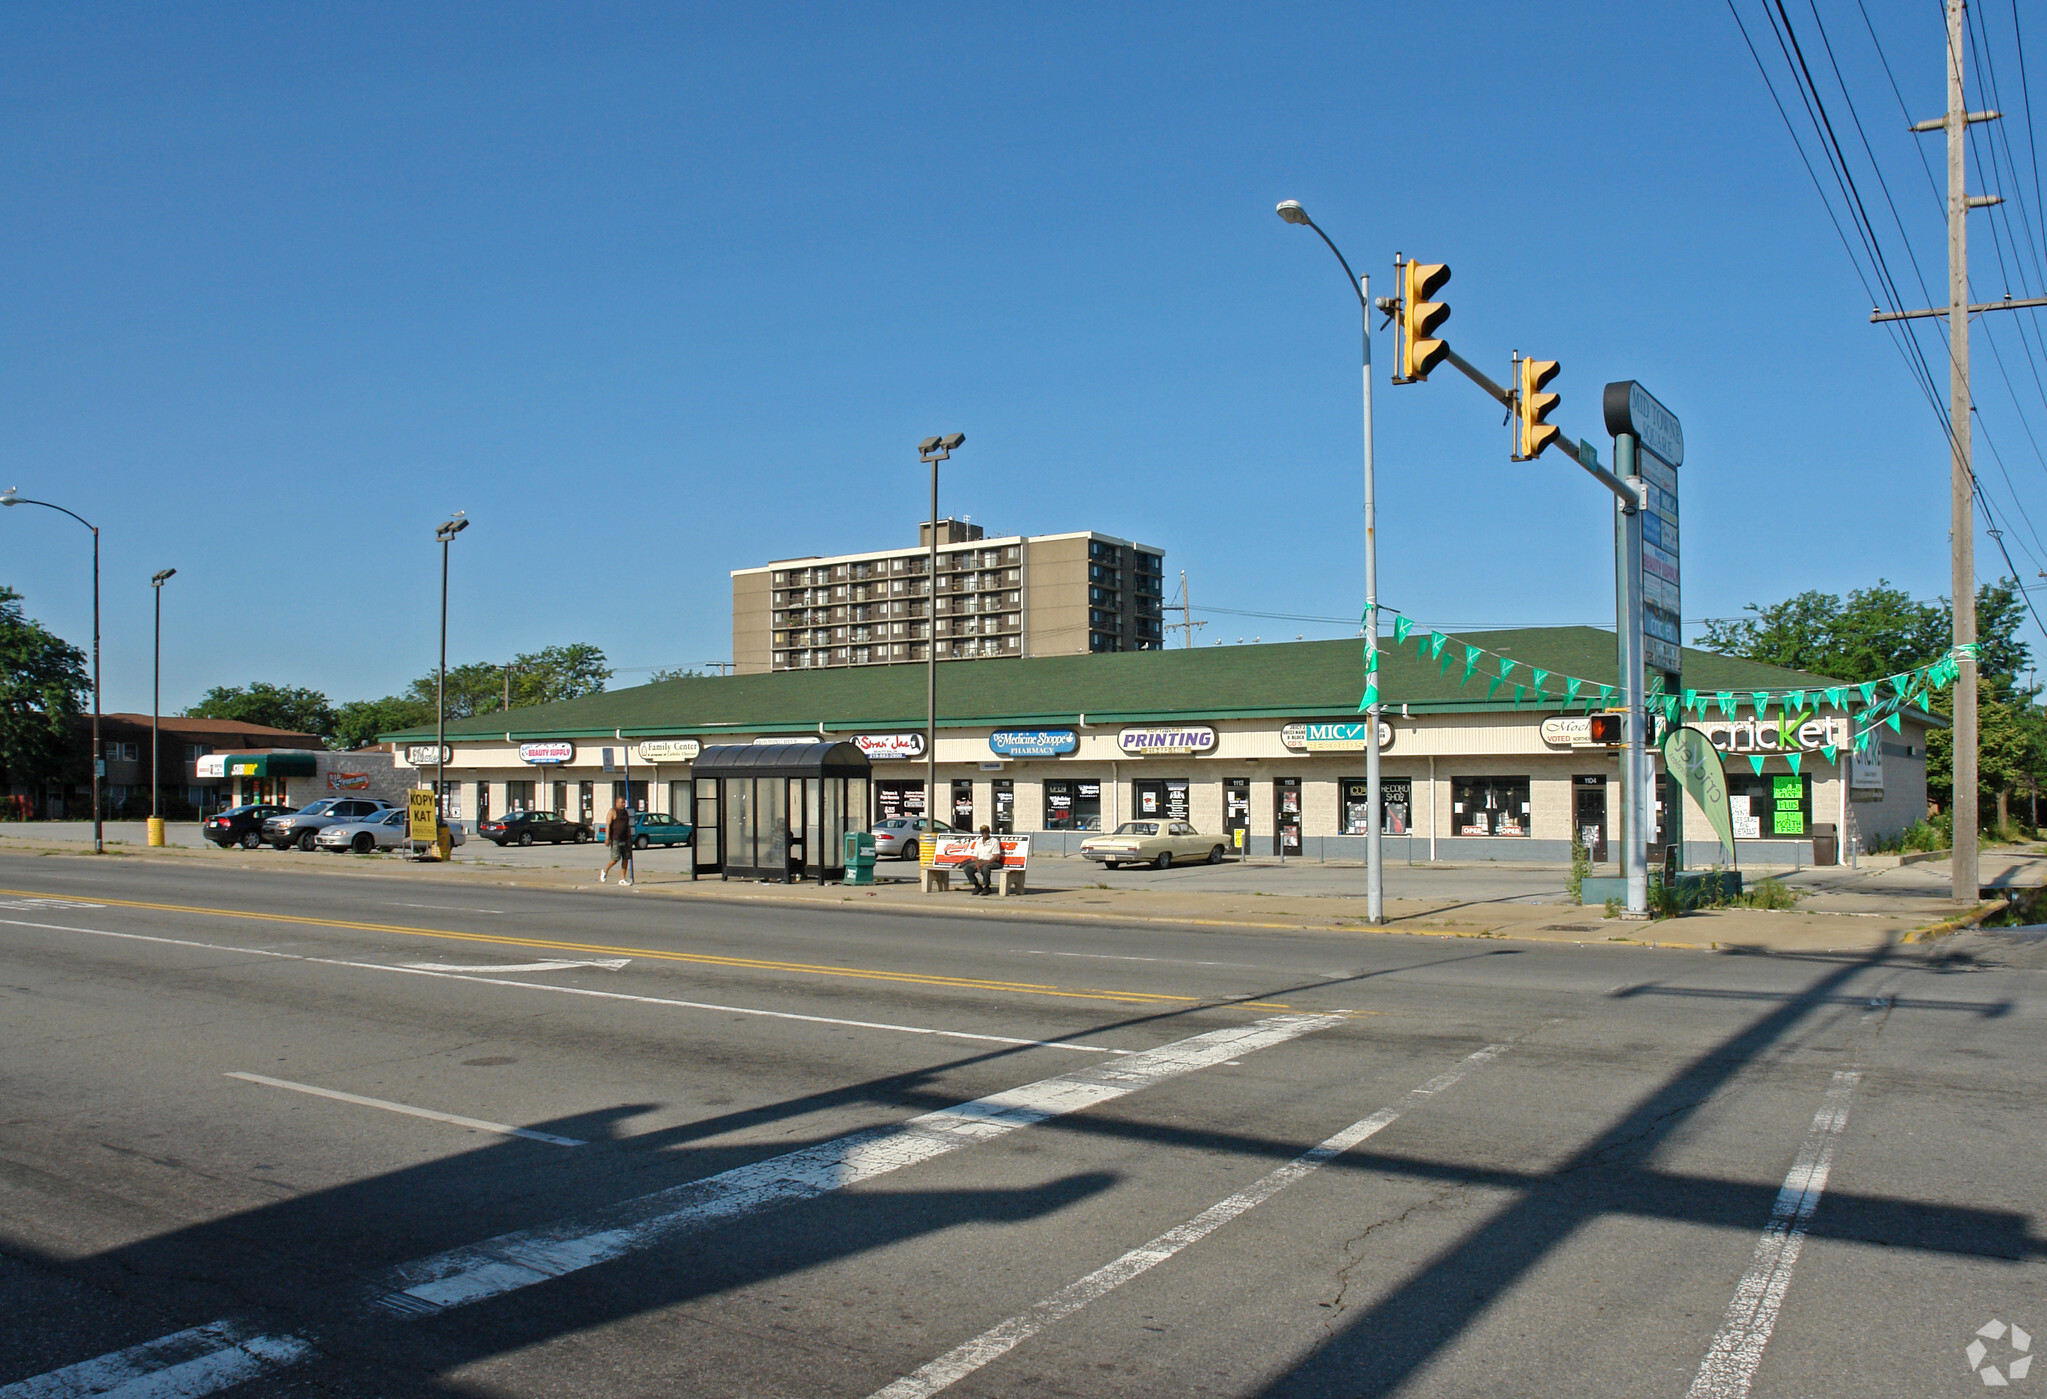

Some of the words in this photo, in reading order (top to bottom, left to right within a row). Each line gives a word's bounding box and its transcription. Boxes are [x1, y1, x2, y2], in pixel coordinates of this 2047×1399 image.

[1632, 387, 1650, 418] MID
[1651, 403, 1681, 445] TOWNE
[1643, 421, 1673, 458] SQUARE
[1309, 724, 1346, 740] MIC
[997, 732, 1037, 748] Medicine
[1037, 732, 1066, 747] Shoppe
[1123, 732, 1211, 748] PRINTING
[1308, 740, 1365, 750] RECORDS
[528, 749, 549, 757] BEAUTY
[549, 748, 571, 757] SUPPLY
[648, 742, 671, 753] Family
[673, 742, 697, 751] Center
[231, 763, 258, 776] SUBWAY
[1381, 785, 1409, 793] RECORD
[410, 794, 434, 807] KOPY
[1779, 800, 1798, 810] PLUS
[413, 810, 432, 822] KAT
[1776, 820, 1801, 828] MONTH
[1463, 827, 1482, 835] OPEN
[1501, 827, 1520, 835] OPEN
